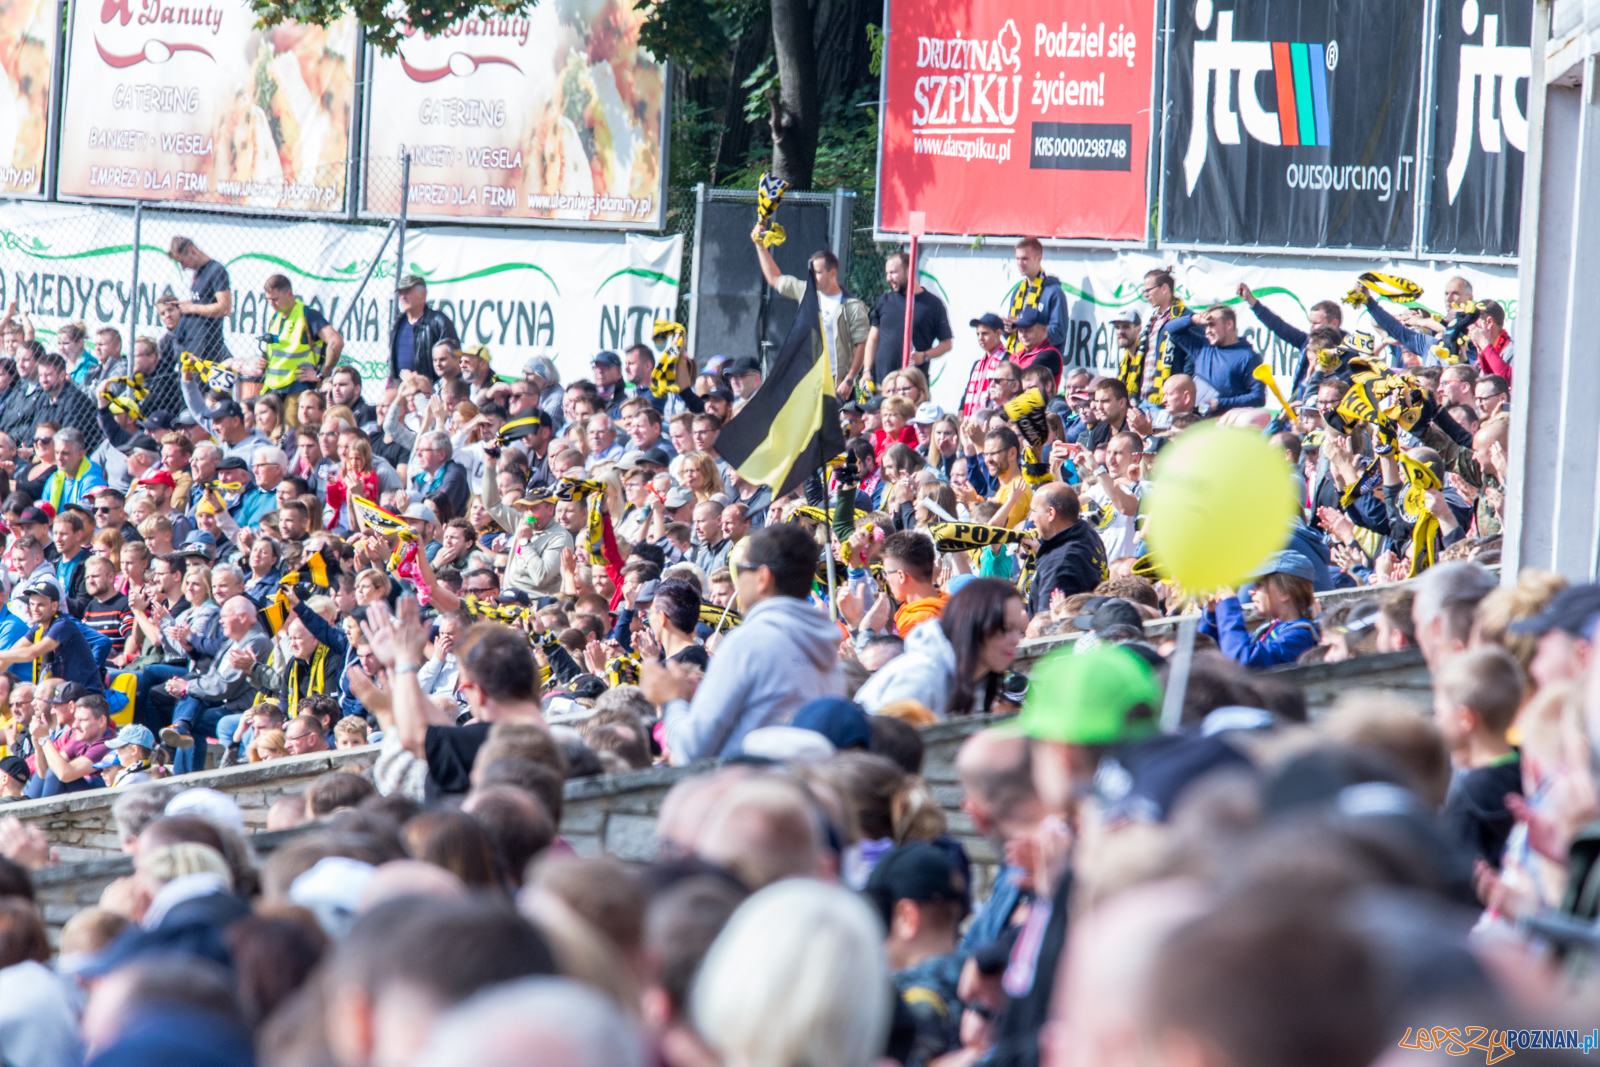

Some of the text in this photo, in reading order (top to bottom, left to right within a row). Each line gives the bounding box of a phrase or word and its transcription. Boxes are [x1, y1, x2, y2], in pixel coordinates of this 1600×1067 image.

[916, 29, 1003, 72] DRUŻYNA
[1035, 22, 1136, 67] Podziel się
[113, 84, 200, 113] CATERING
[912, 72, 1022, 126] SZPIKU
[1031, 71, 1105, 114] życiem!
[1183, 0, 1282, 197] jtc
[418, 98, 506, 128] CATERING
[88, 128, 214, 156] BANKIETY WESELA
[914, 135, 1012, 165] www.darszpiku.pl
[466, 147, 523, 169] WESELA
[90, 166, 208, 193] IMPREZY DLA FIRM
[1286, 155, 1414, 202] outsourcing IT
[407, 183, 517, 208] MPREZY DLA FIRM
